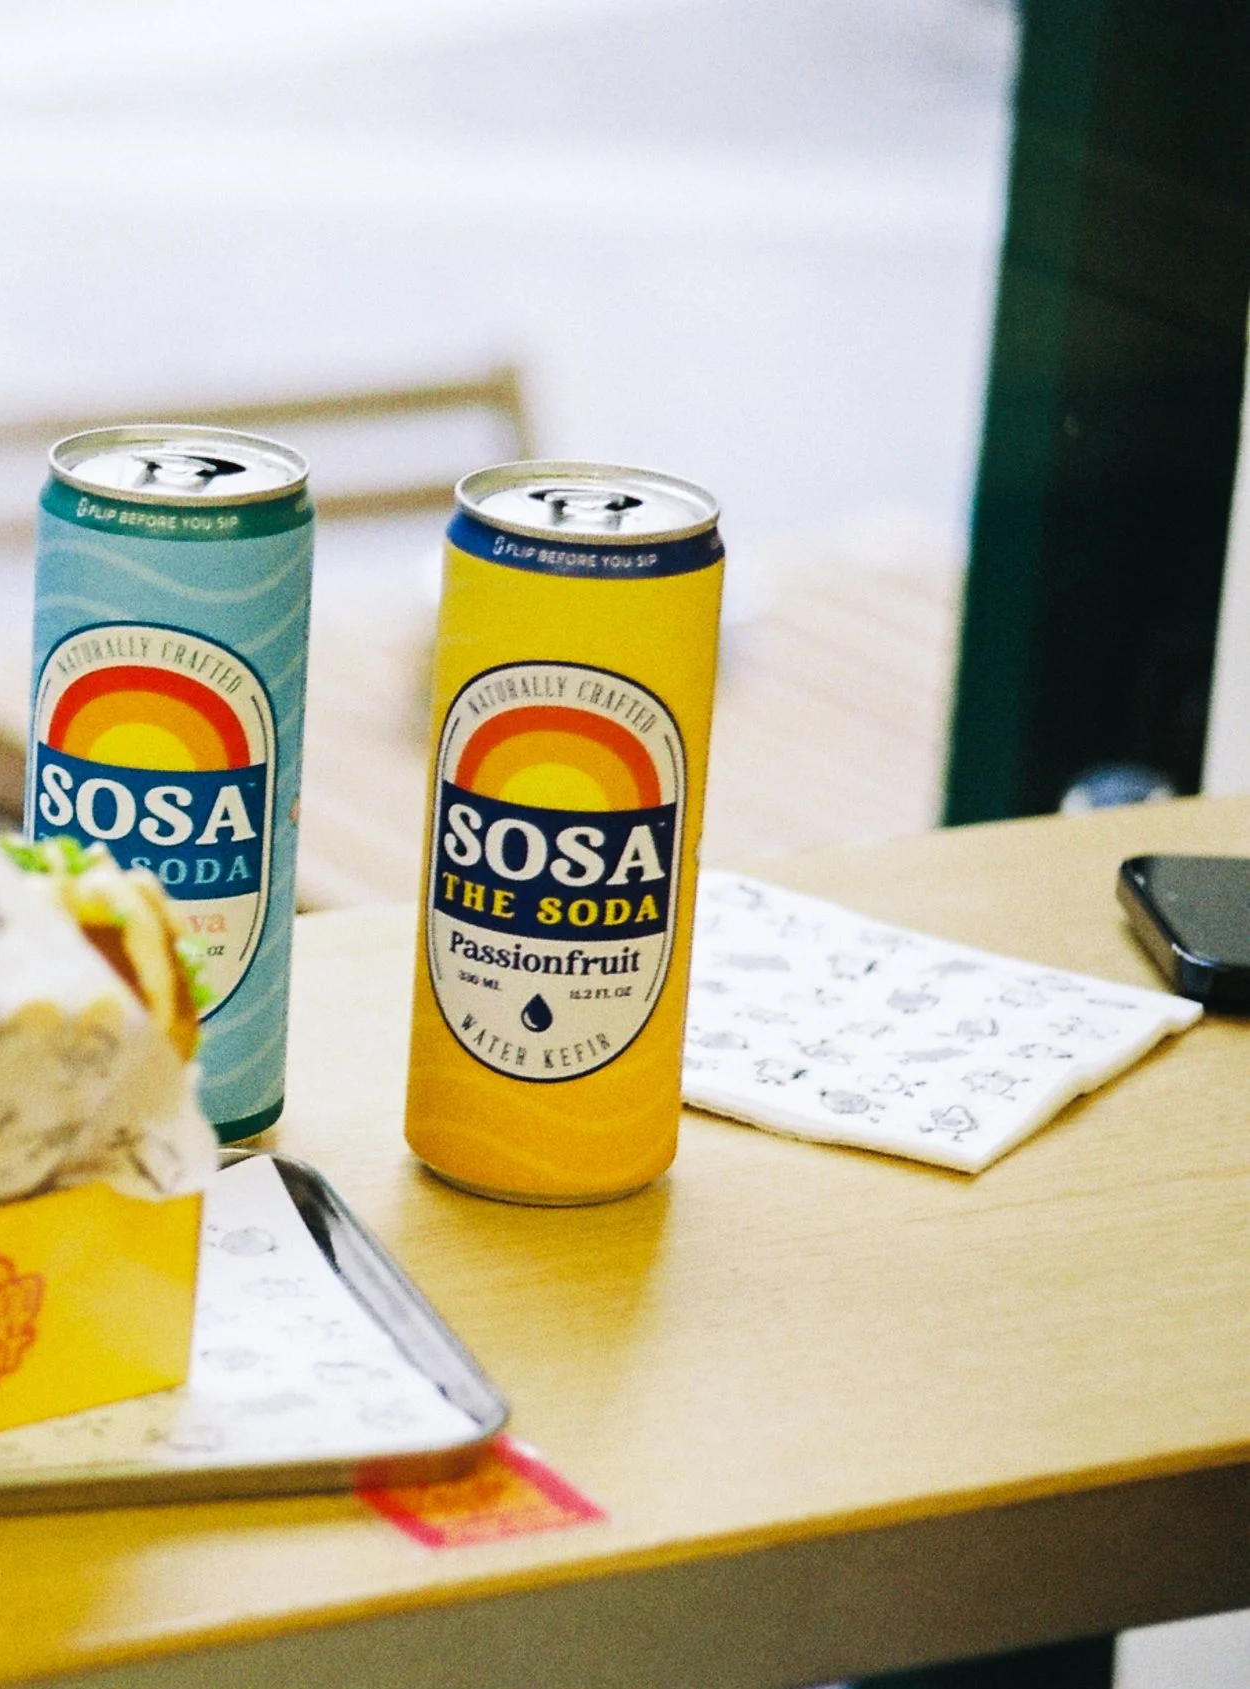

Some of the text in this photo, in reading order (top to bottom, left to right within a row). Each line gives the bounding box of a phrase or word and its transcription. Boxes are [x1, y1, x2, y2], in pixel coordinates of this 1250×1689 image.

[88, 503, 239, 531] FLIP BEFORE YOU SIP
[505, 542, 658, 568] FLIP BEFORE YOU SIP
[57, 636, 243, 694] NATURALLY CRAFTED
[468, 676, 657, 733] NATURALLY CRAFTED
[39, 763, 257, 846] SOSA
[444, 803, 666, 887] SOSA
[442, 871, 659, 927] THE SODA
[449, 930, 641, 976] Passionfruit
[461, 1013, 611, 1069] WATER KEFIR
